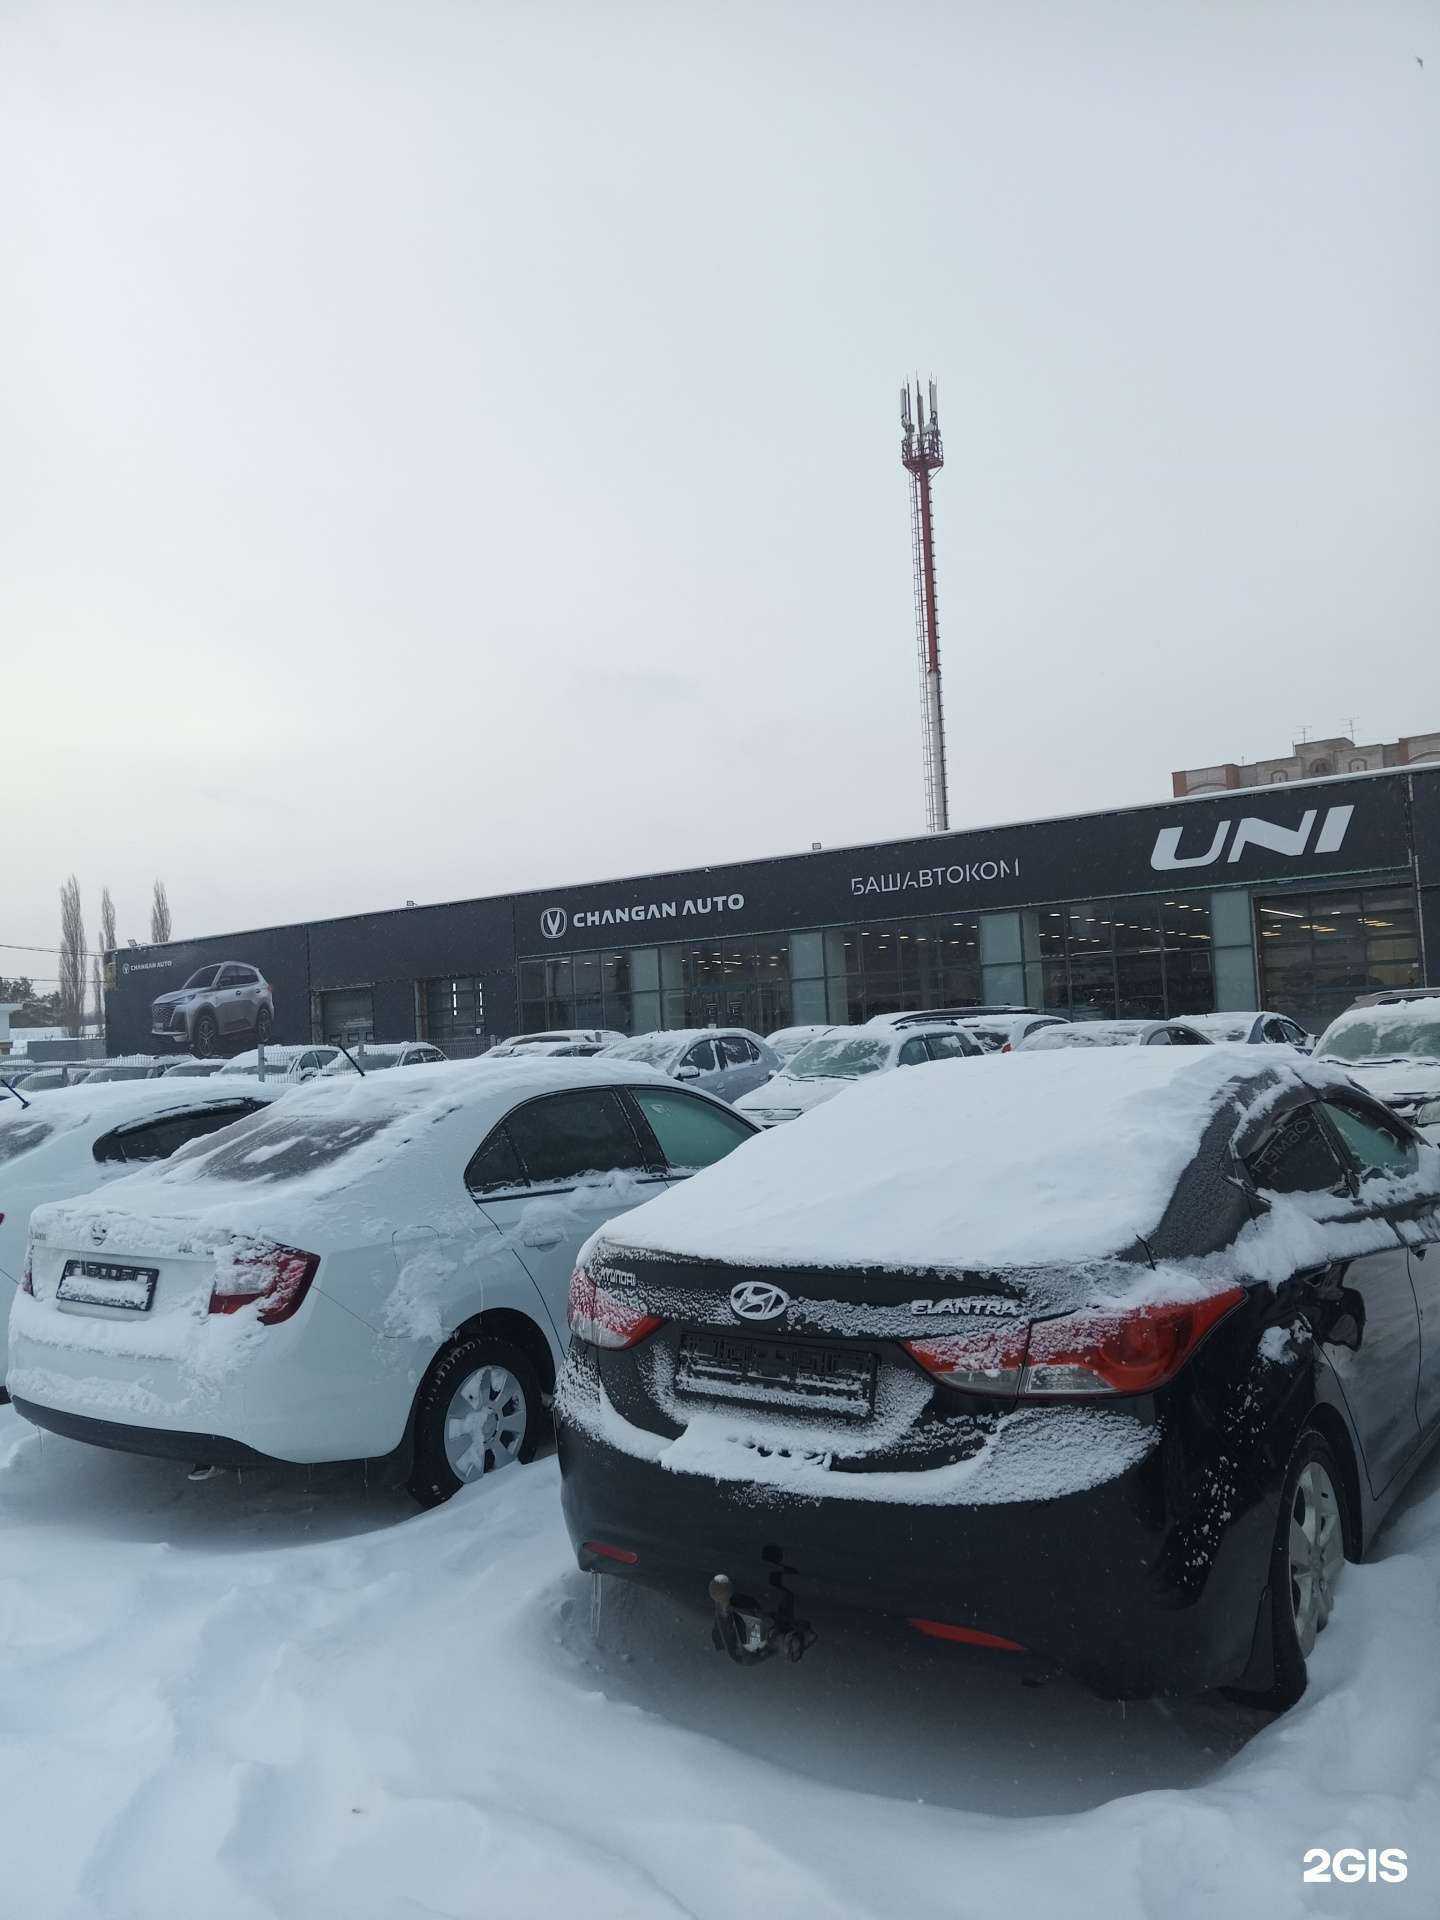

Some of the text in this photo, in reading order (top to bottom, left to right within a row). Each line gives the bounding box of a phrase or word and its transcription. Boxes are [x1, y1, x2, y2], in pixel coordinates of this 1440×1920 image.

[1150, 805, 1355, 871] UNI
[851, 858, 1020, 896] БАШАВТОКОМ
[572, 893, 745, 928] CHANGAN AUTO
[911, 1299, 1018, 1316] ELANTRA
